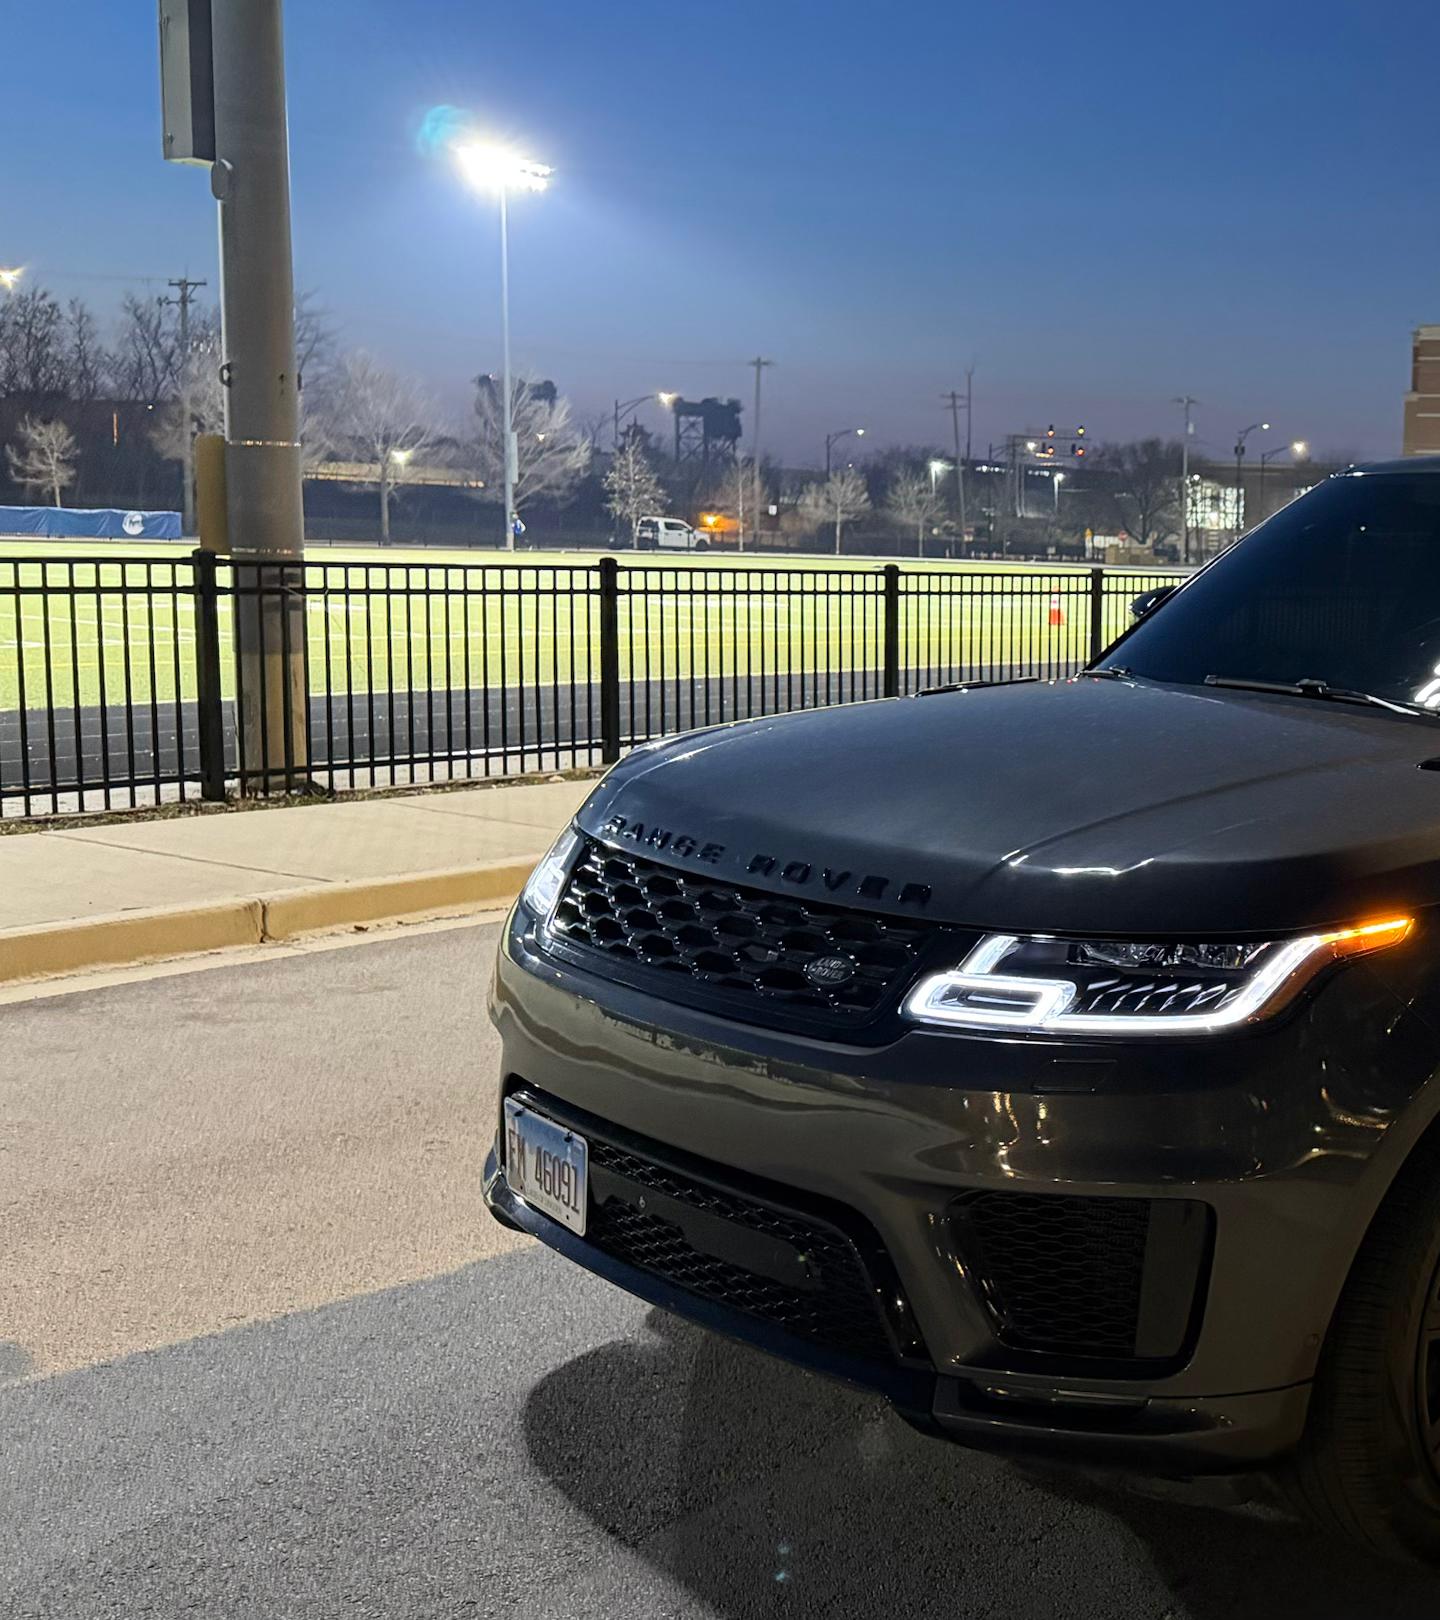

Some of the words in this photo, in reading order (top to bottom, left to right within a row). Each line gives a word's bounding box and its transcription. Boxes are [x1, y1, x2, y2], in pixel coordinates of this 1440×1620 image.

[602, 814, 726, 865] RANGE
[745, 853, 932, 907] ROVER
[535, 1145, 580, 1213] 46091
